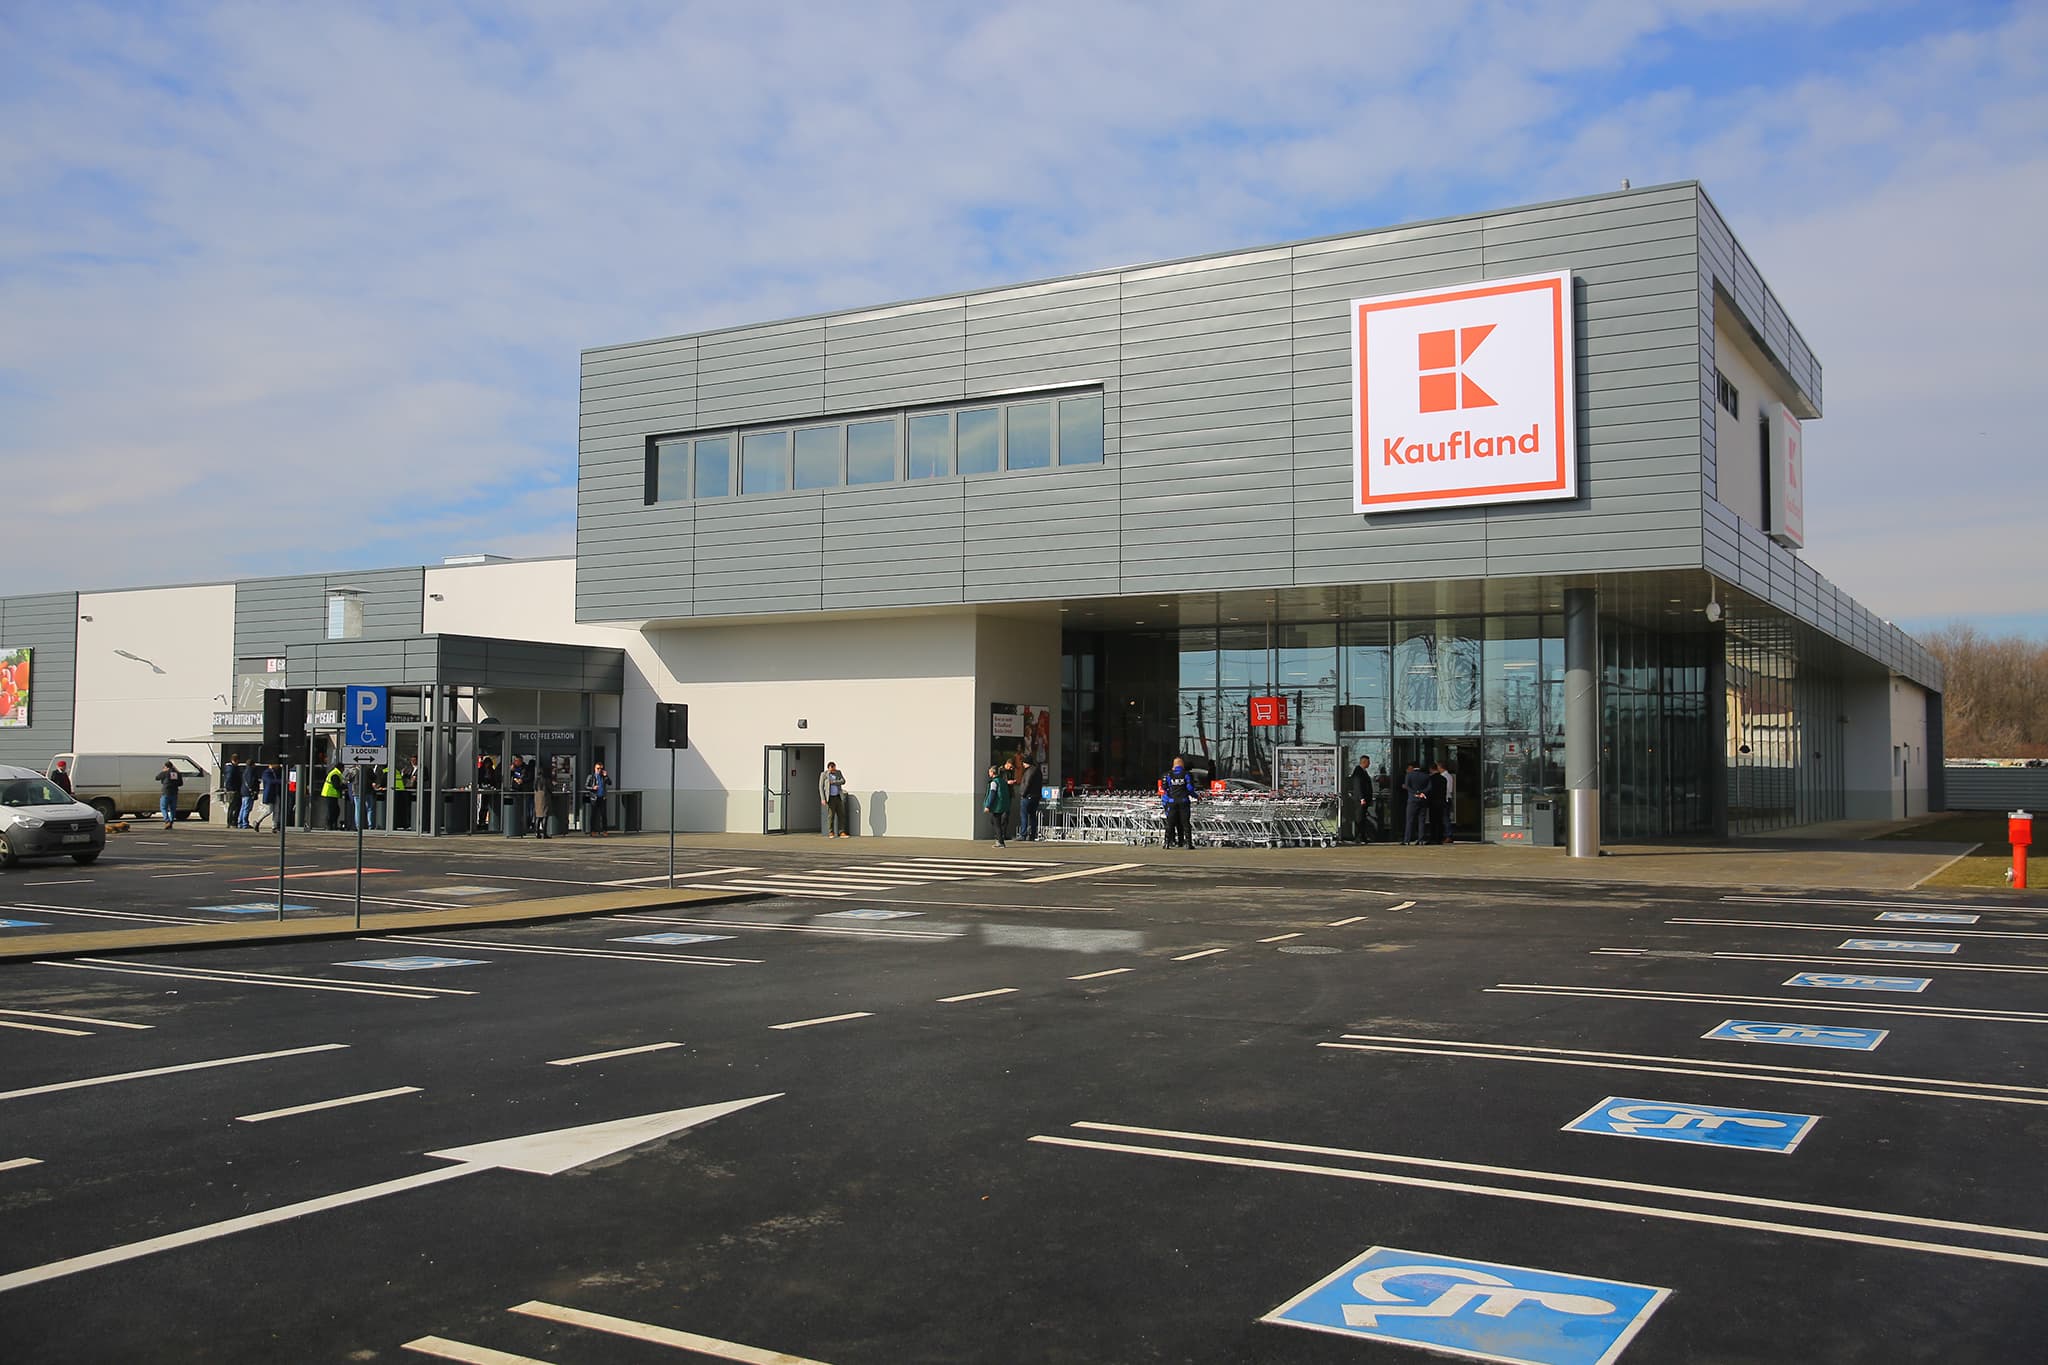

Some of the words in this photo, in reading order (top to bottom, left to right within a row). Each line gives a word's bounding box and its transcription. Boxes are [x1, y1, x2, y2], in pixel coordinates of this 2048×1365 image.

[1383, 423, 1539, 466] Kaufland
[356, 690, 378, 725] P
[519, 732, 530, 740] THE
[551, 732, 575, 740] STATION
